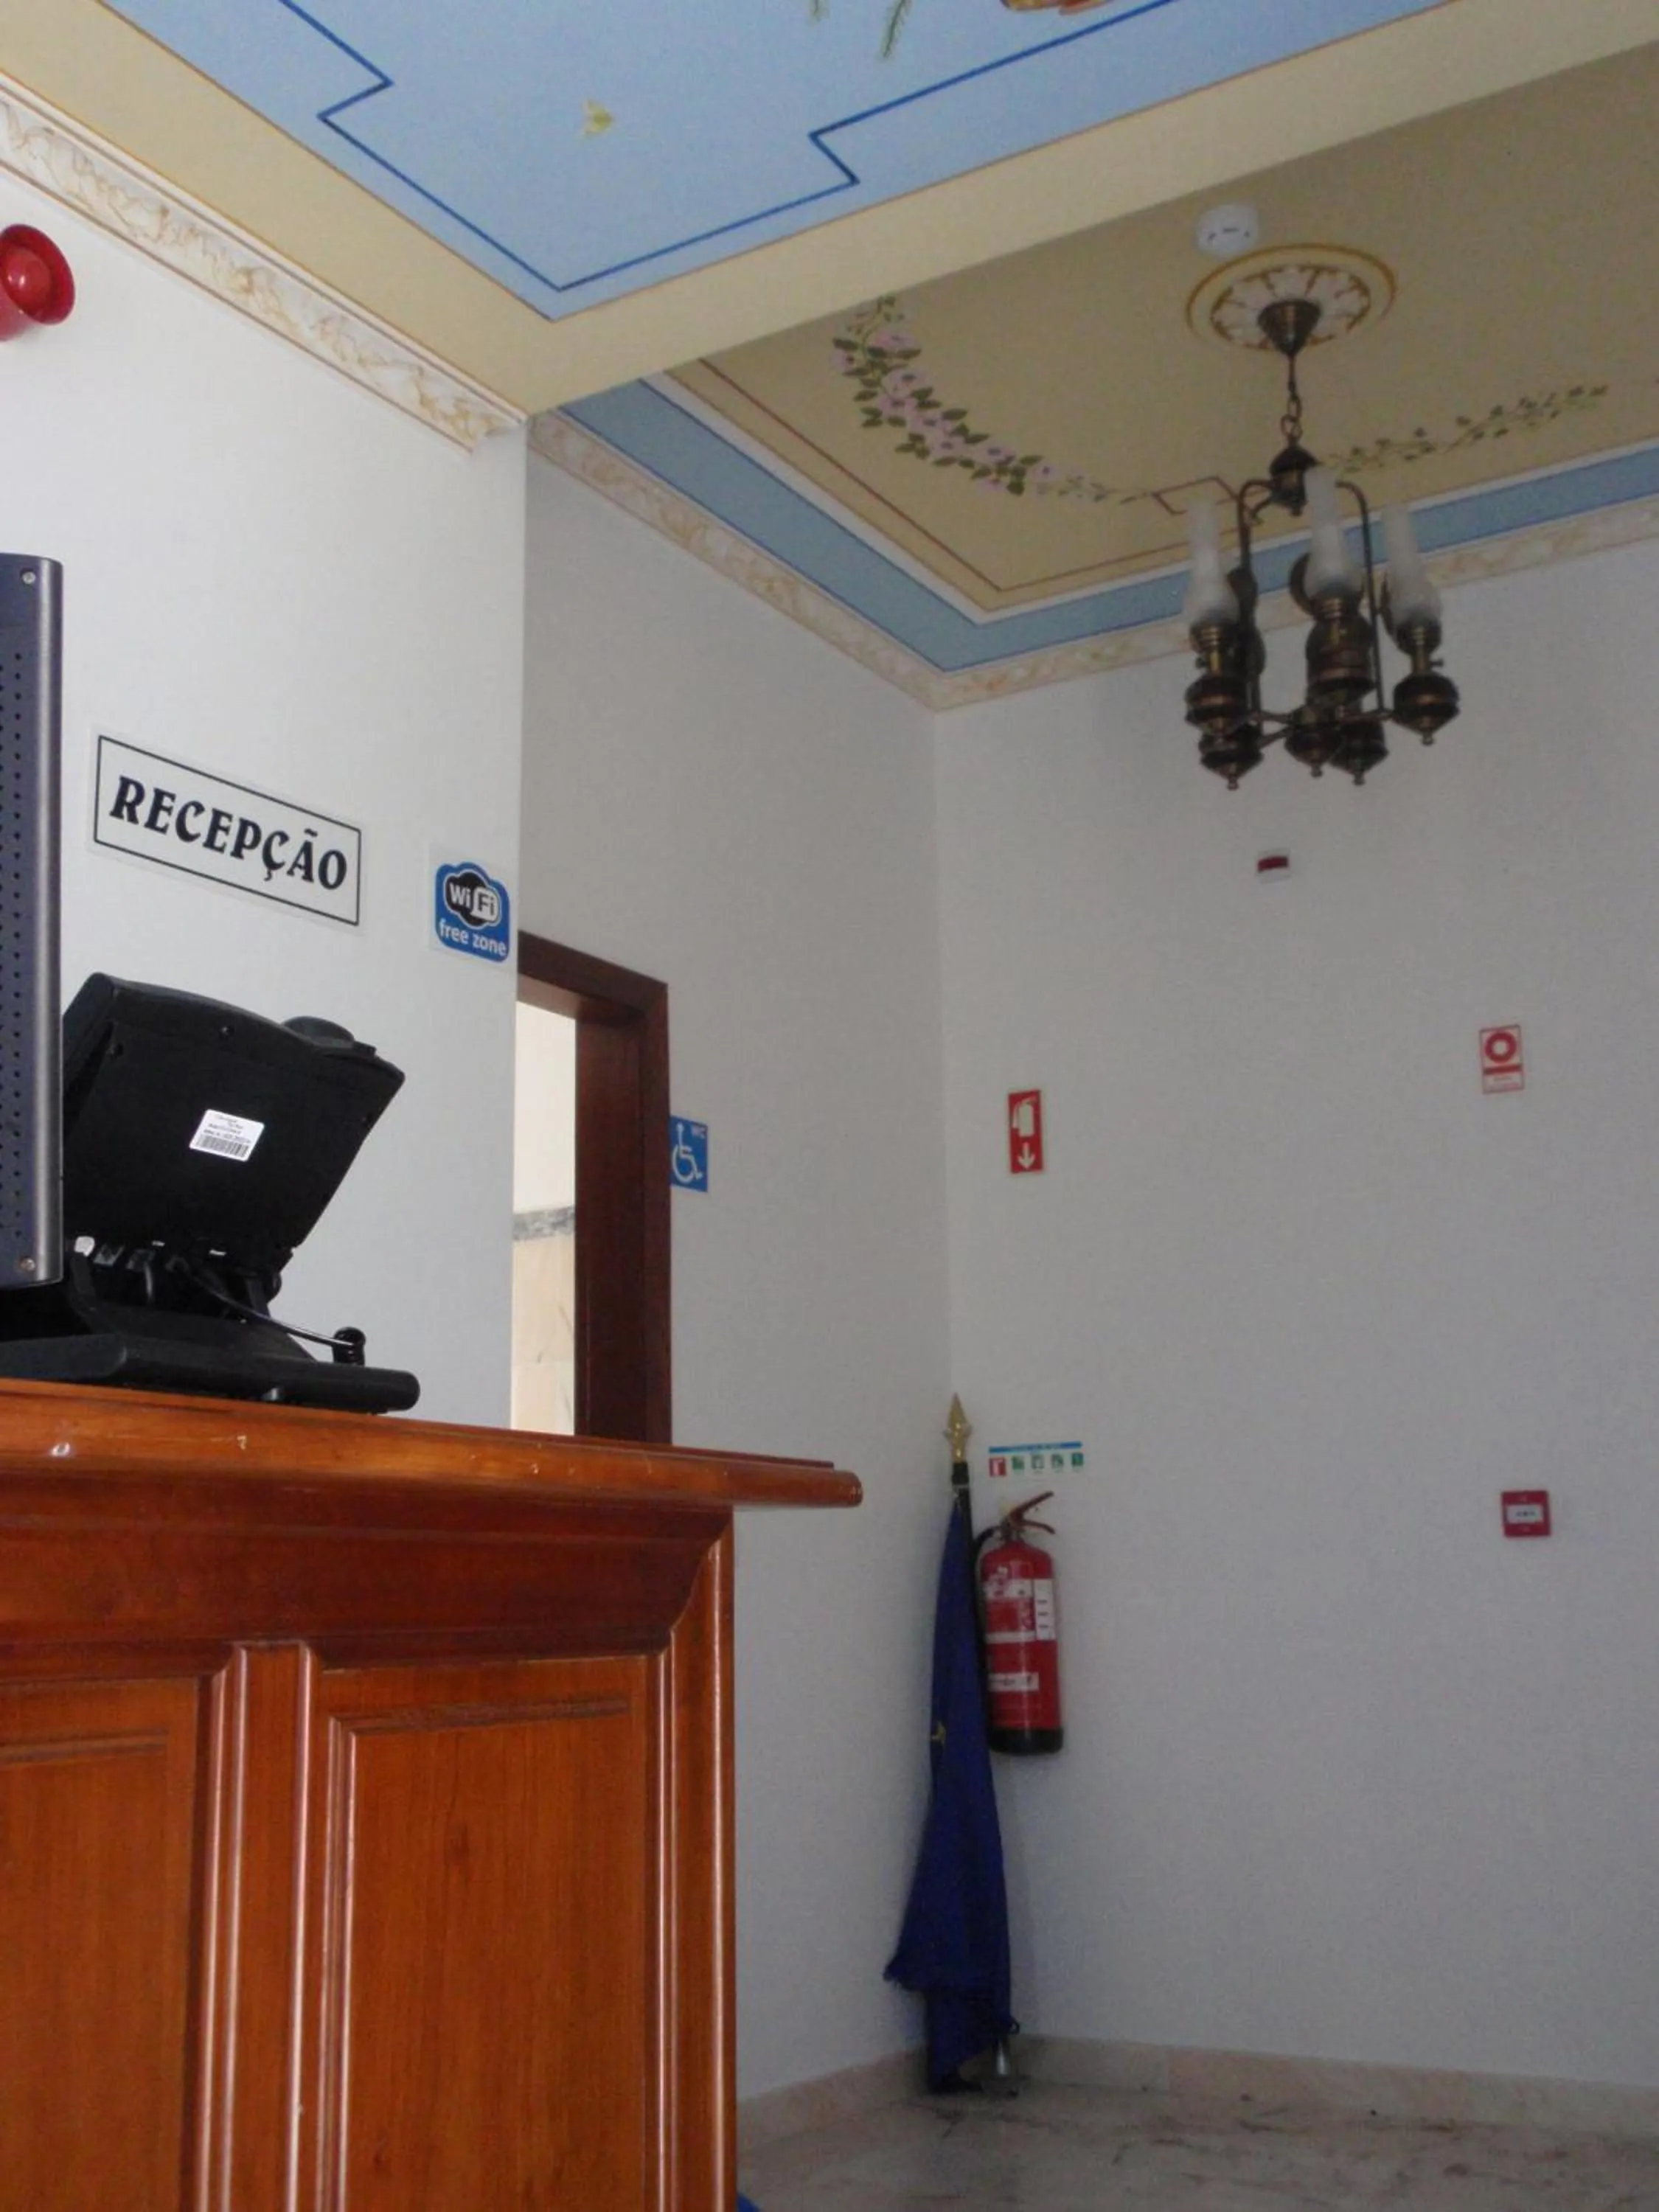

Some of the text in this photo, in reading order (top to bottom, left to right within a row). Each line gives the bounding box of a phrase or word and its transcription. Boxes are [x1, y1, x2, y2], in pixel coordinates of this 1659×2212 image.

[109, 775, 347, 890] RECEPÇÃO
[439, 917, 507, 956] free zone
